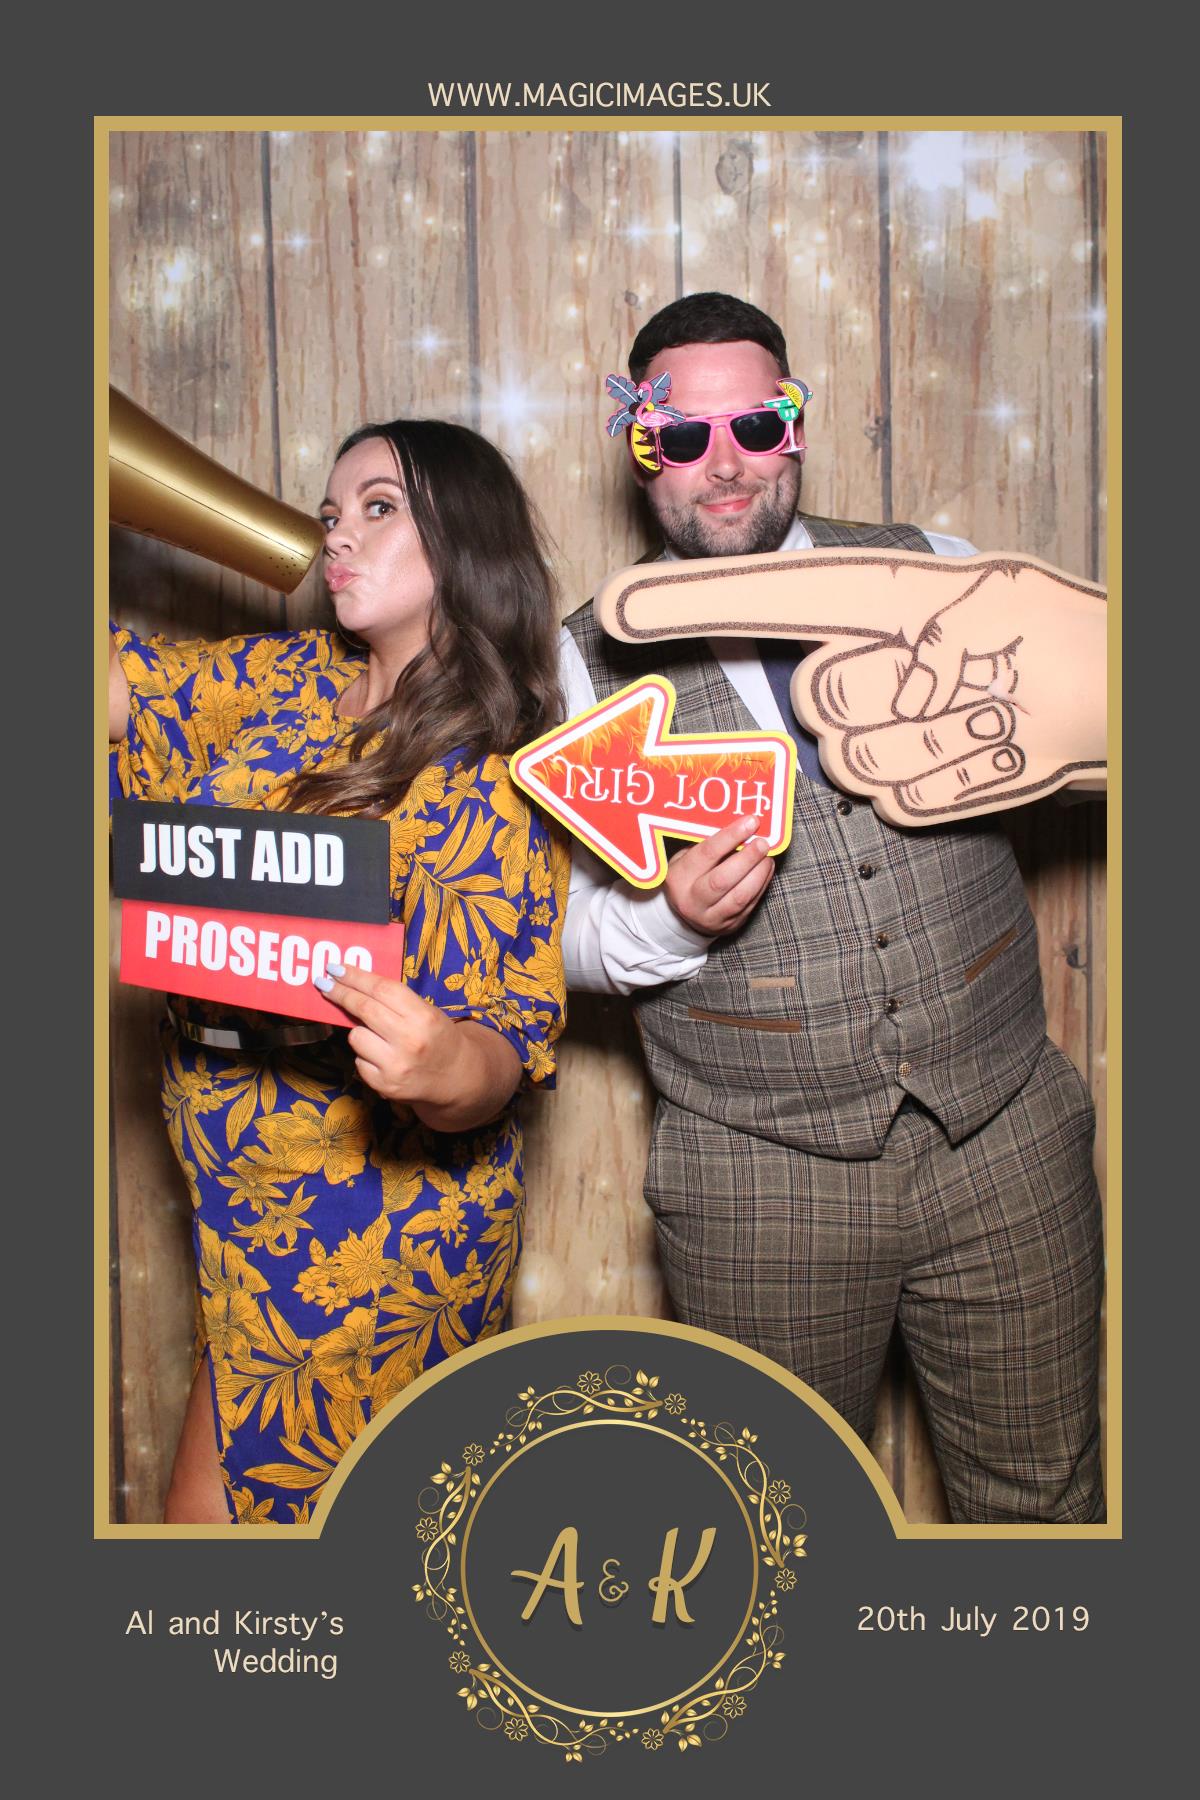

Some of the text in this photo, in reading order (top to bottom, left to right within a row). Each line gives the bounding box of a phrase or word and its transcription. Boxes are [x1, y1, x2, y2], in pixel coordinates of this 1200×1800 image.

[551, 755, 771, 817] HOT GIRL
[140, 823, 344, 887] JUST ADD
